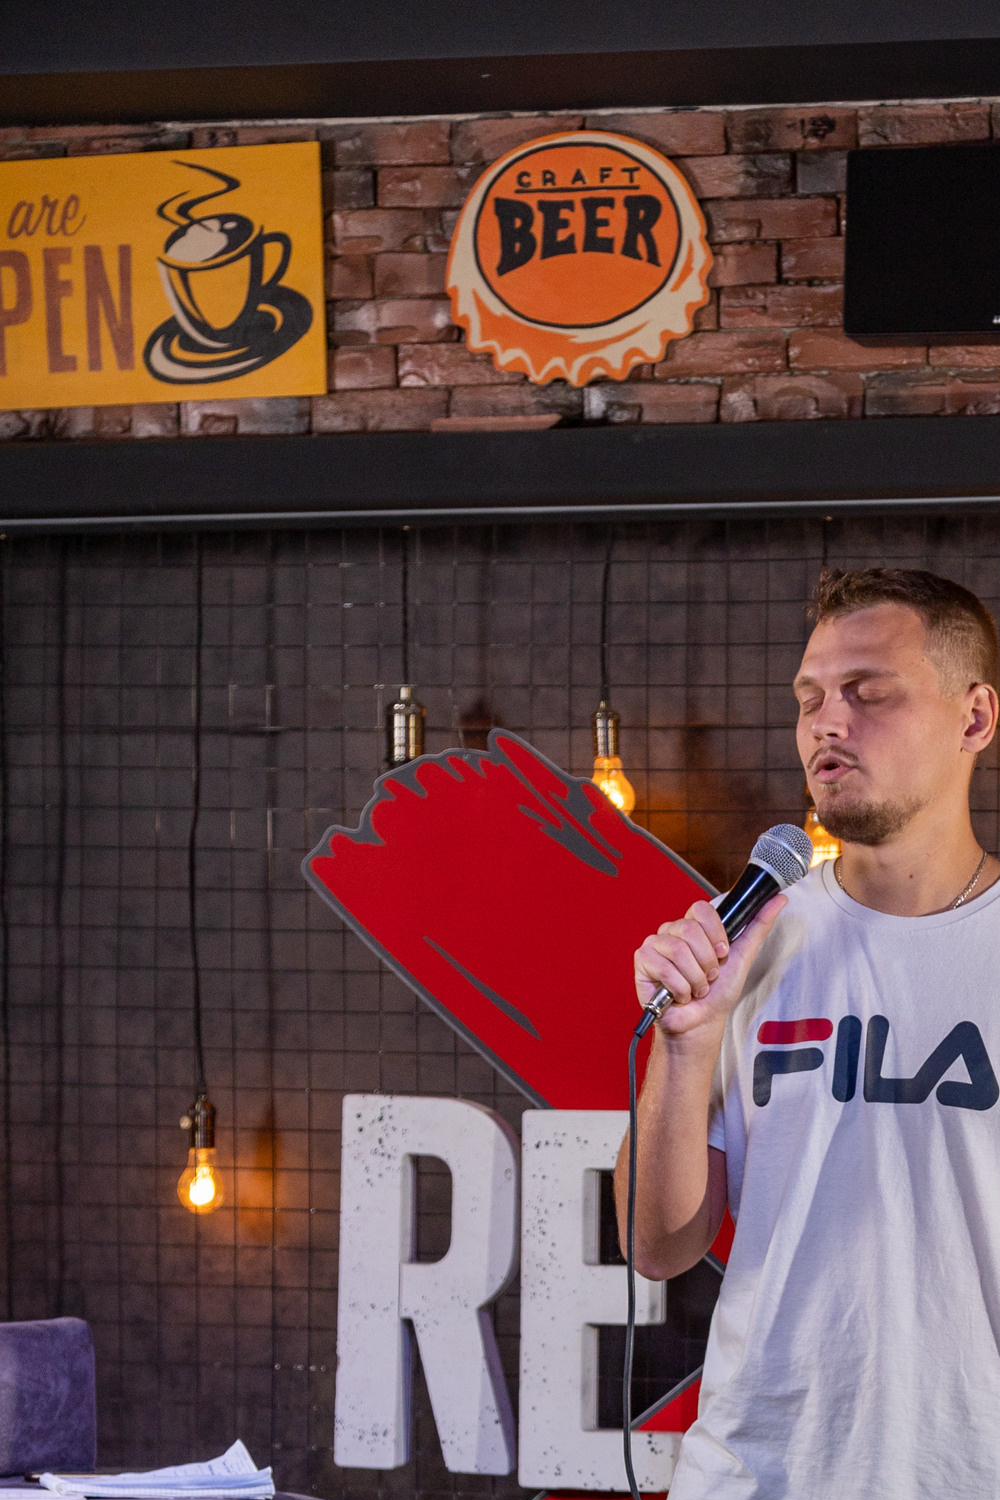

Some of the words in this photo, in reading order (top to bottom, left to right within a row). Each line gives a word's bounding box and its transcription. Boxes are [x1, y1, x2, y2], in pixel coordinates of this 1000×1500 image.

[516, 167, 640, 188] CRAFT
[7, 194, 88, 239] are
[494, 195, 662, 277] BEER
[752, 1014, 1000, 1111] FILA
